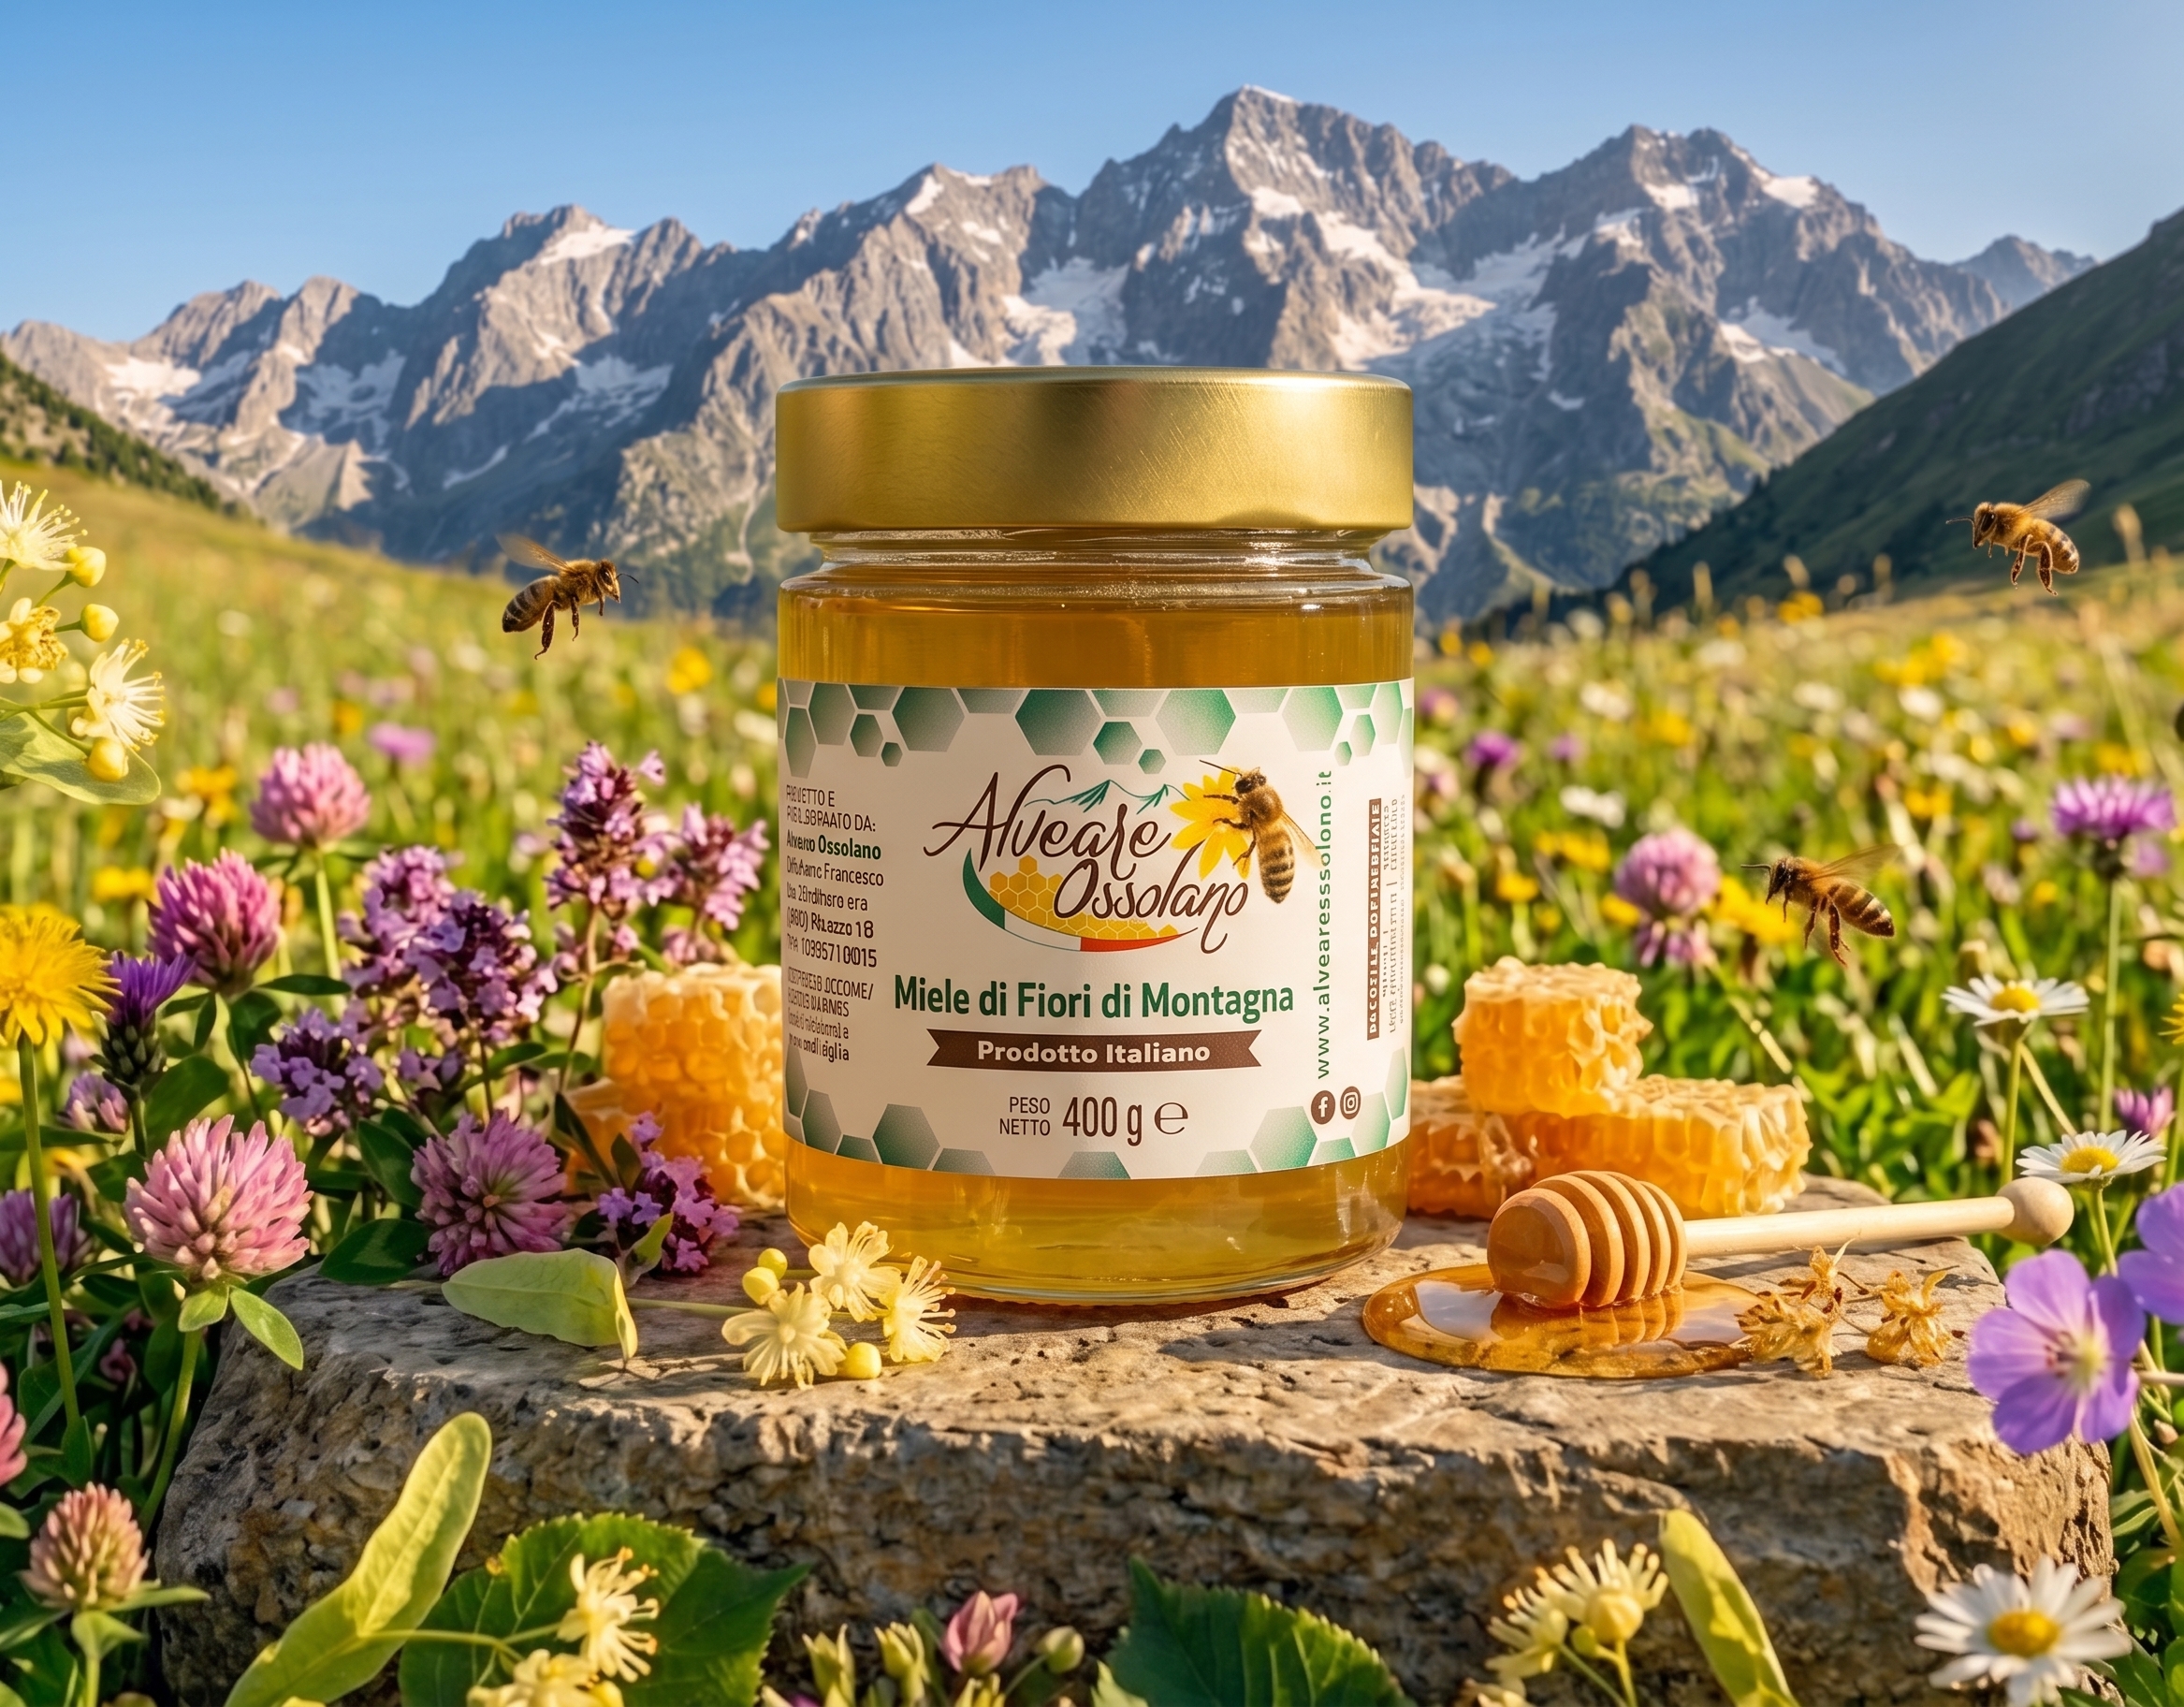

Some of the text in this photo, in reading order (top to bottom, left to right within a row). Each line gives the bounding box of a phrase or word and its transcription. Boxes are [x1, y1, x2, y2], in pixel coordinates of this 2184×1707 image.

[854, 813, 876, 832] DA:
[923, 764, 1172, 881] Alveare
[818, 834, 881, 860] Ossolano
[823, 862, 884, 887] Francesco
[1053, 839, 1249, 955] Ossolano
[854, 920, 874, 939] 18
[894, 974, 1295, 1024] Miele di Fiori di Montagna
[977, 1041, 1211, 1064] Prodotto Italiano
[1009, 1096, 1051, 1115] PESO
[999, 1119, 1051, 1136] NETTO
[1062, 1096, 1119, 1137] 400
[1127, 1104, 1143, 1147] g
